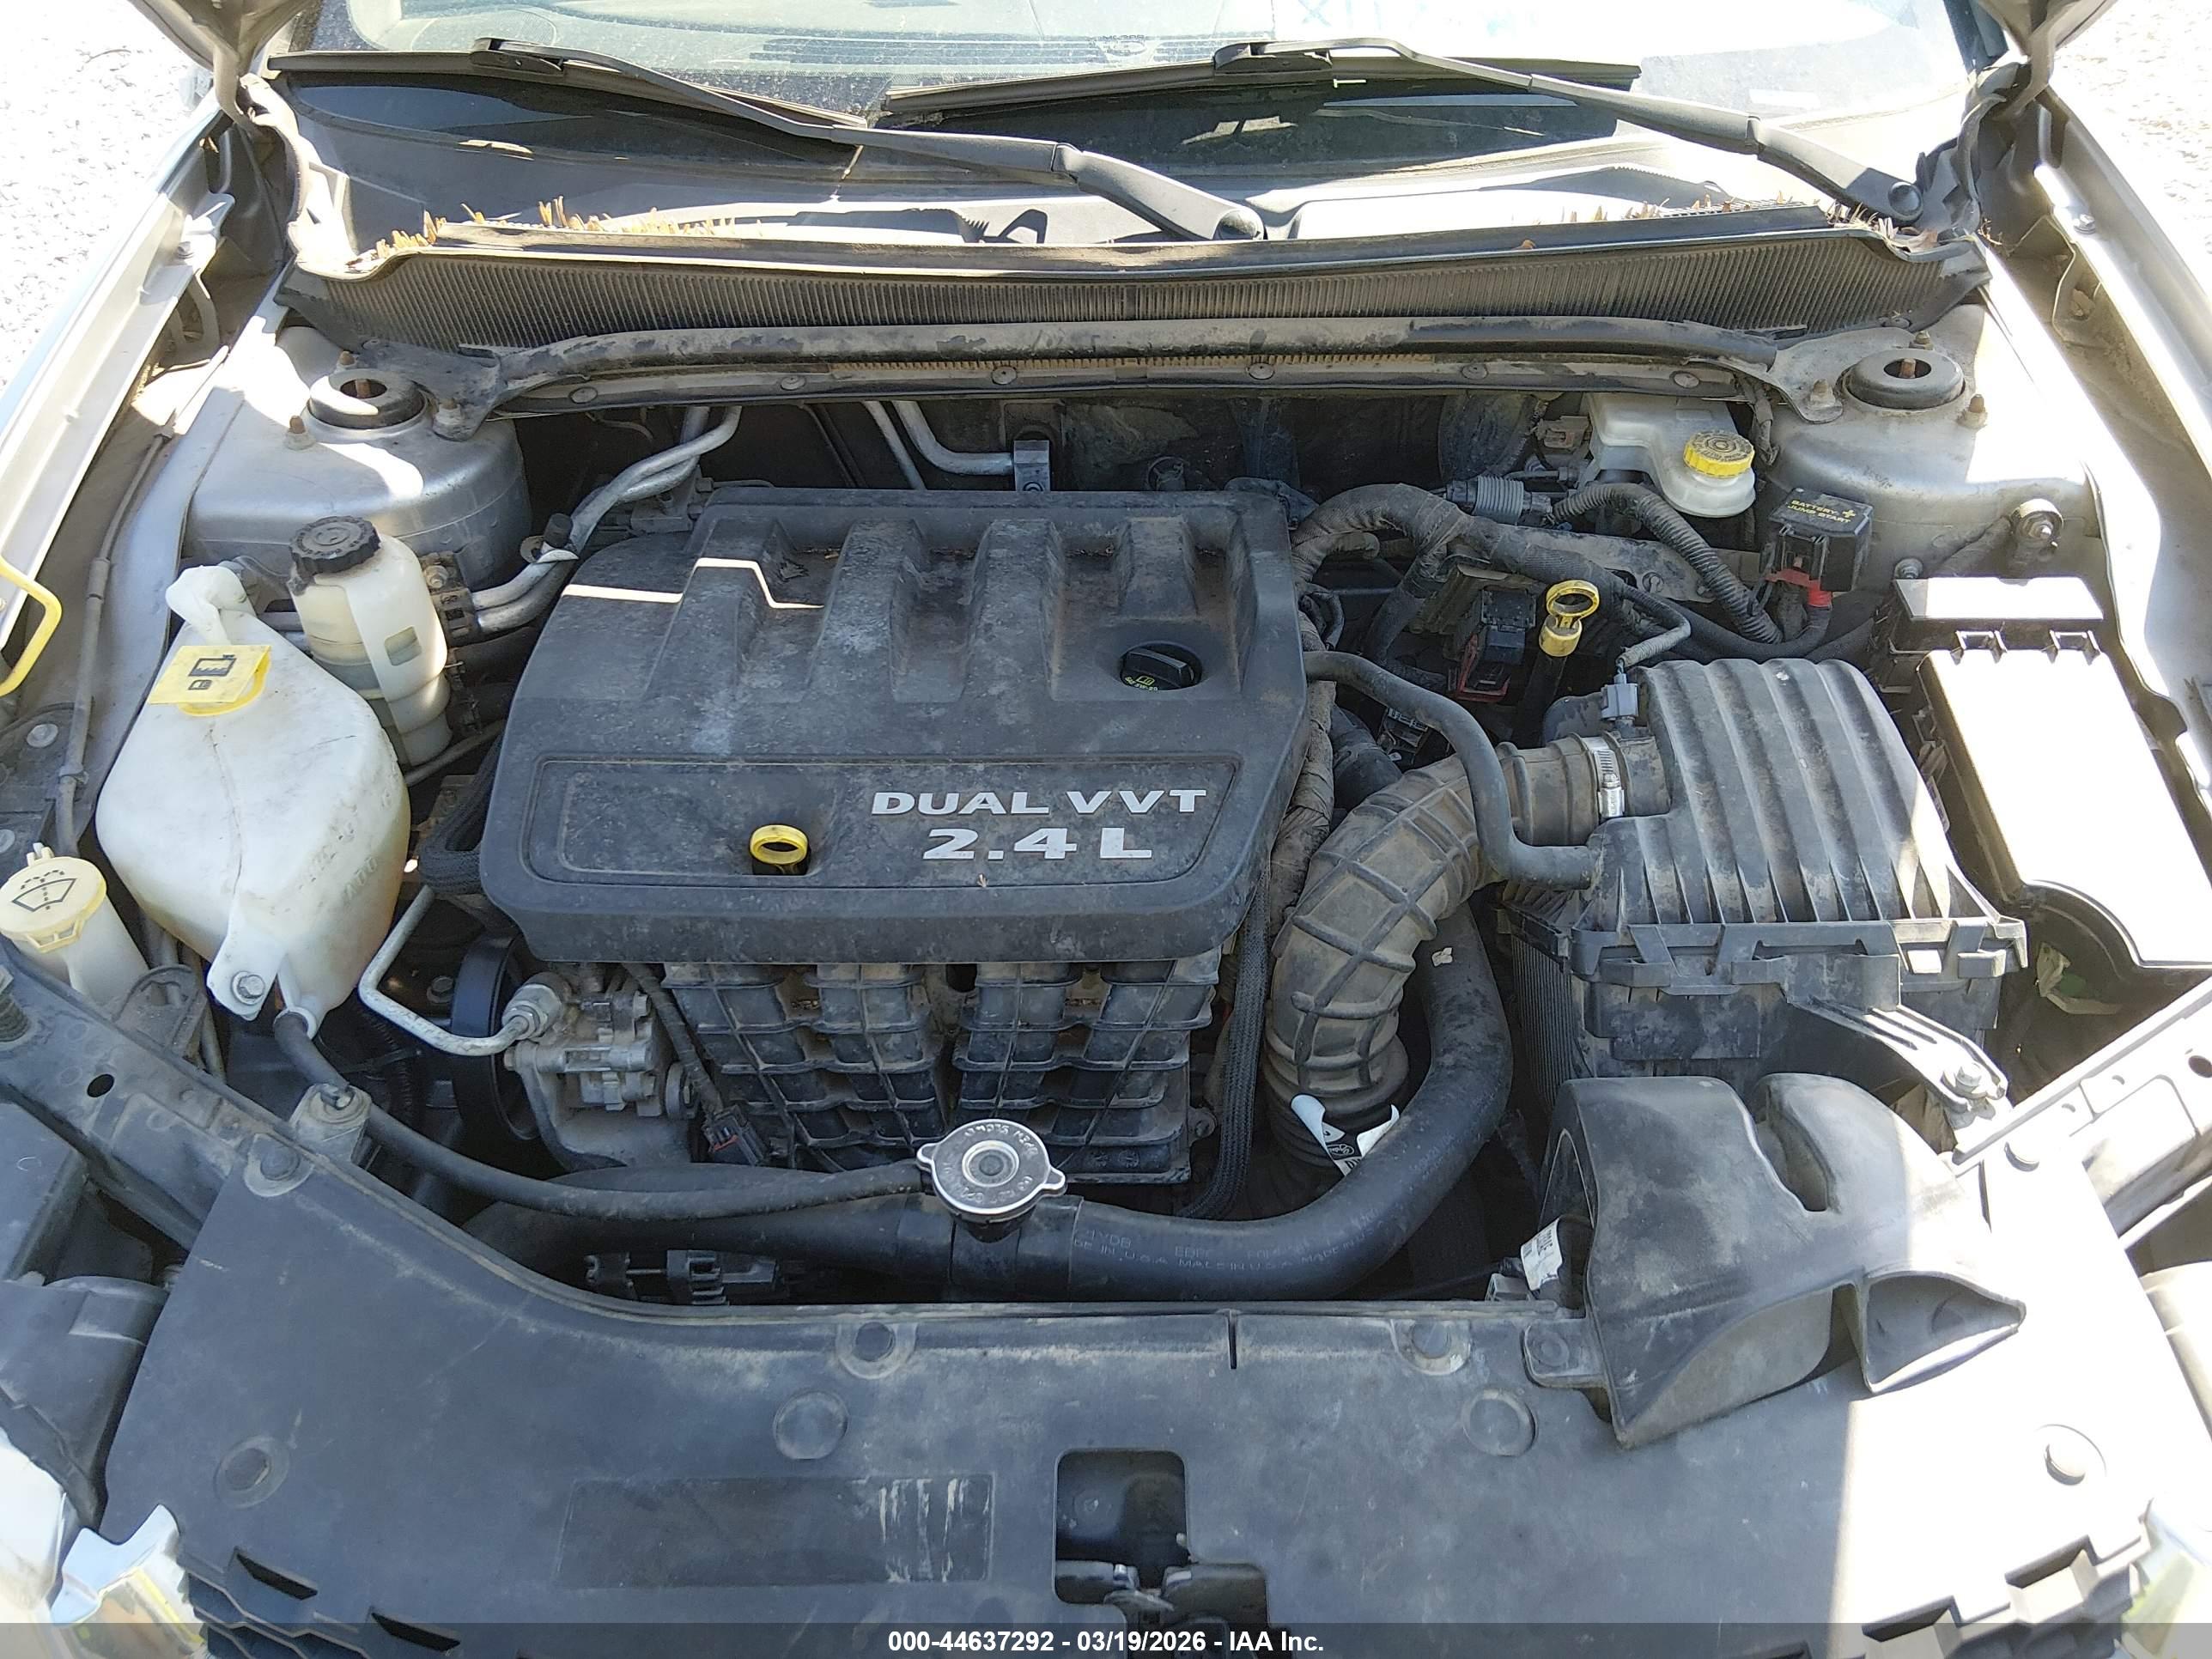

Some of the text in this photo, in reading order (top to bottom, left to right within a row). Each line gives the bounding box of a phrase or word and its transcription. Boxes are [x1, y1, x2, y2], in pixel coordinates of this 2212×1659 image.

[1787, 504, 1851, 524] JUMP START
[1790, 499, 1837, 515] BATTERY
[1134, 682, 1158, 691] 5W-20
[872, 788, 1207, 816] DUAL VVT
[922, 826, 1152, 860] 2.4 L
